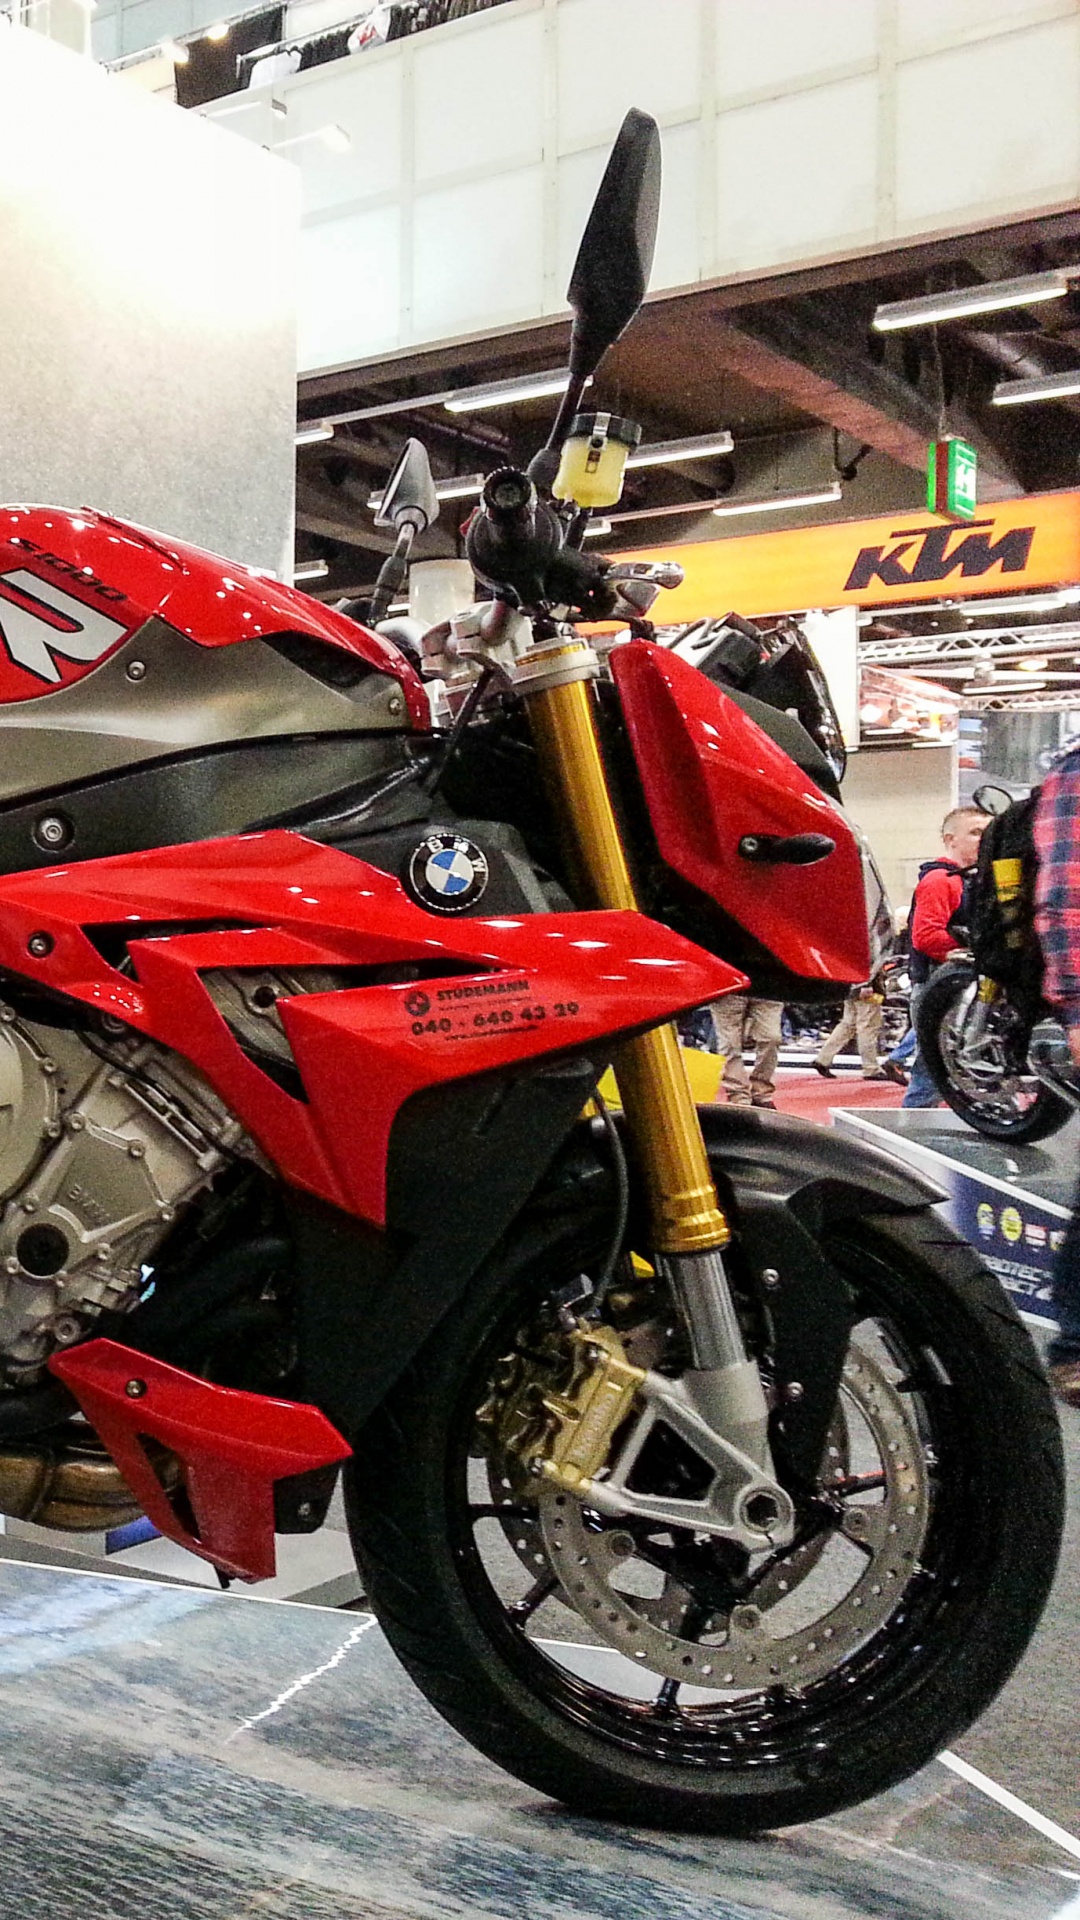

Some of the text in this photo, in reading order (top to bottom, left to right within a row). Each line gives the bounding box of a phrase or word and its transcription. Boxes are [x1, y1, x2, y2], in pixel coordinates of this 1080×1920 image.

[843, 519, 1037, 591] KTM
[411, 1017, 452, 1037] 040
[473, 1009, 513, 1028] 640
[520, 1005, 546, 1021] 43
[554, 1001, 579, 1017] 29
